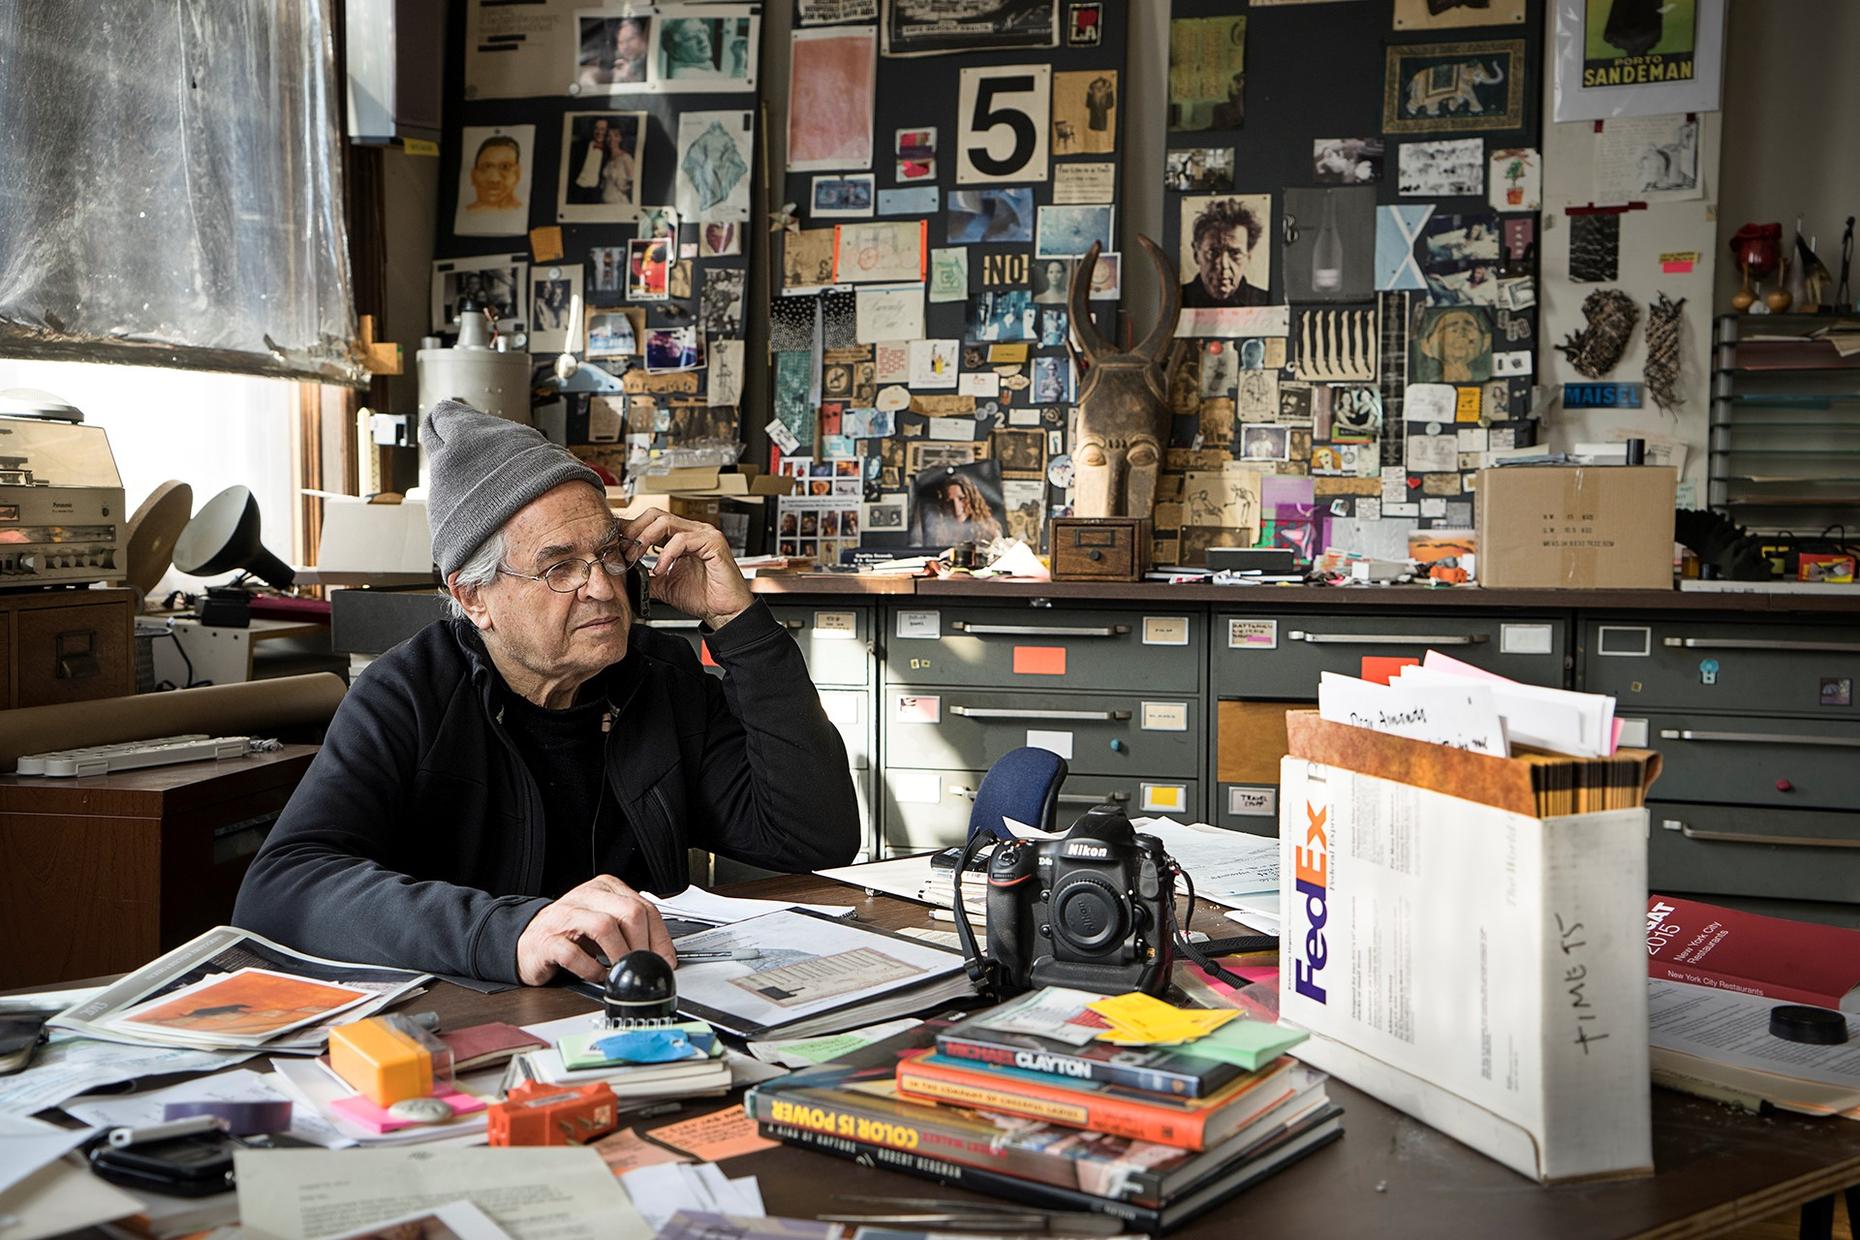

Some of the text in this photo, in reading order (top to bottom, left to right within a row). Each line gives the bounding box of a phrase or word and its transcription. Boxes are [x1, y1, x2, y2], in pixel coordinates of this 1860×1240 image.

[1584, 61, 1692, 86] SANDEMAN
[1614, 55, 1663, 66] PORTO
[967, 74, 1037, 177] 5
[983, 254, 1029, 285] NO
[1565, 386, 1641, 404] MAISEL
[994, 411, 1006, 429] 2
[1068, 843, 1108, 858] Nikon
[1295, 799, 1328, 1006] FedEx
[1647, 923, 1681, 956] 2015
[1673, 920, 1722, 961] New York City
[1686, 929, 1729, 964] Restaurants
[1667, 969, 1764, 996] New York City Restaurants
[1015, 1051, 1092, 1079] CLAYTON
[770, 1099, 838, 1134] POWER
[838, 1111, 856, 1137] IS
[857, 1116, 920, 1150] COLOR
